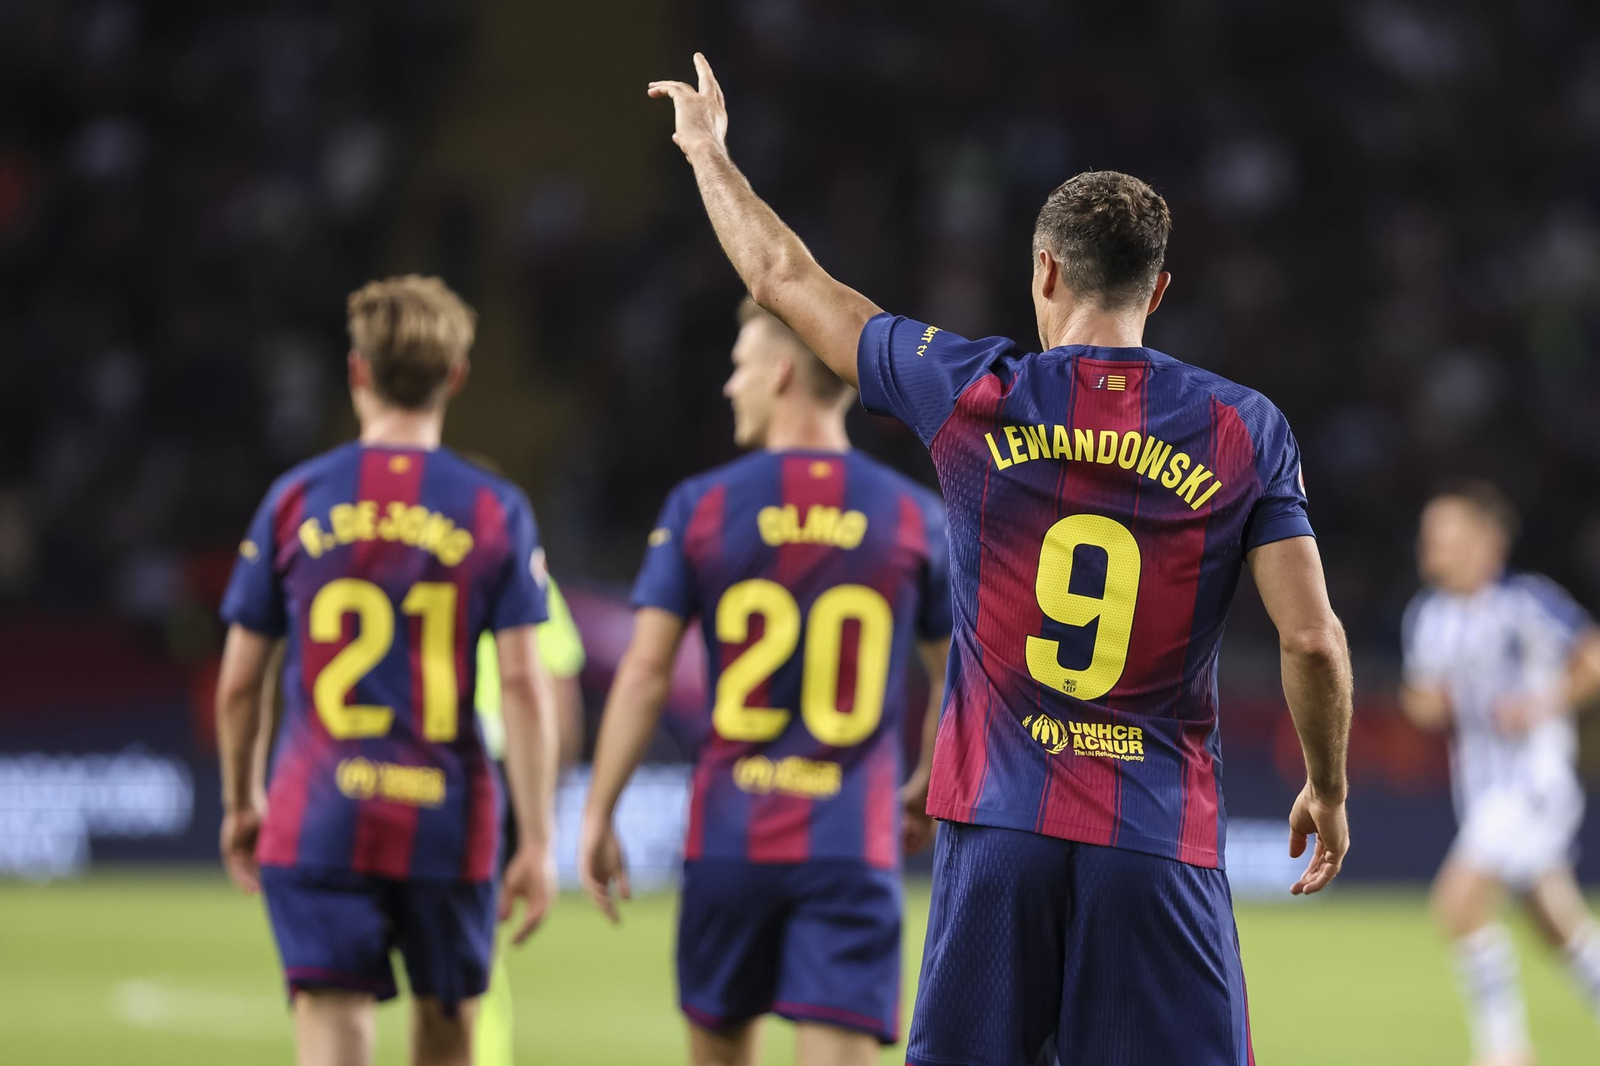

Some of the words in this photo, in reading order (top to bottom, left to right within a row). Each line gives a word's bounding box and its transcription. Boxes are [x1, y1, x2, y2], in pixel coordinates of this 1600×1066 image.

[916, 344, 928, 357] tv
[985, 424, 1222, 511] LEWANDOWSKI
[757, 503, 868, 550] OLMO
[1025, 514, 1141, 701] 9
[309, 577, 457, 742] 21
[712, 578, 893, 747] 20
[1068, 720, 1143, 740] UNHCR
[1073, 734, 1144, 754] ACNUR
[1074, 749, 1086, 757] The
[1120, 754, 1144, 762] Agency
